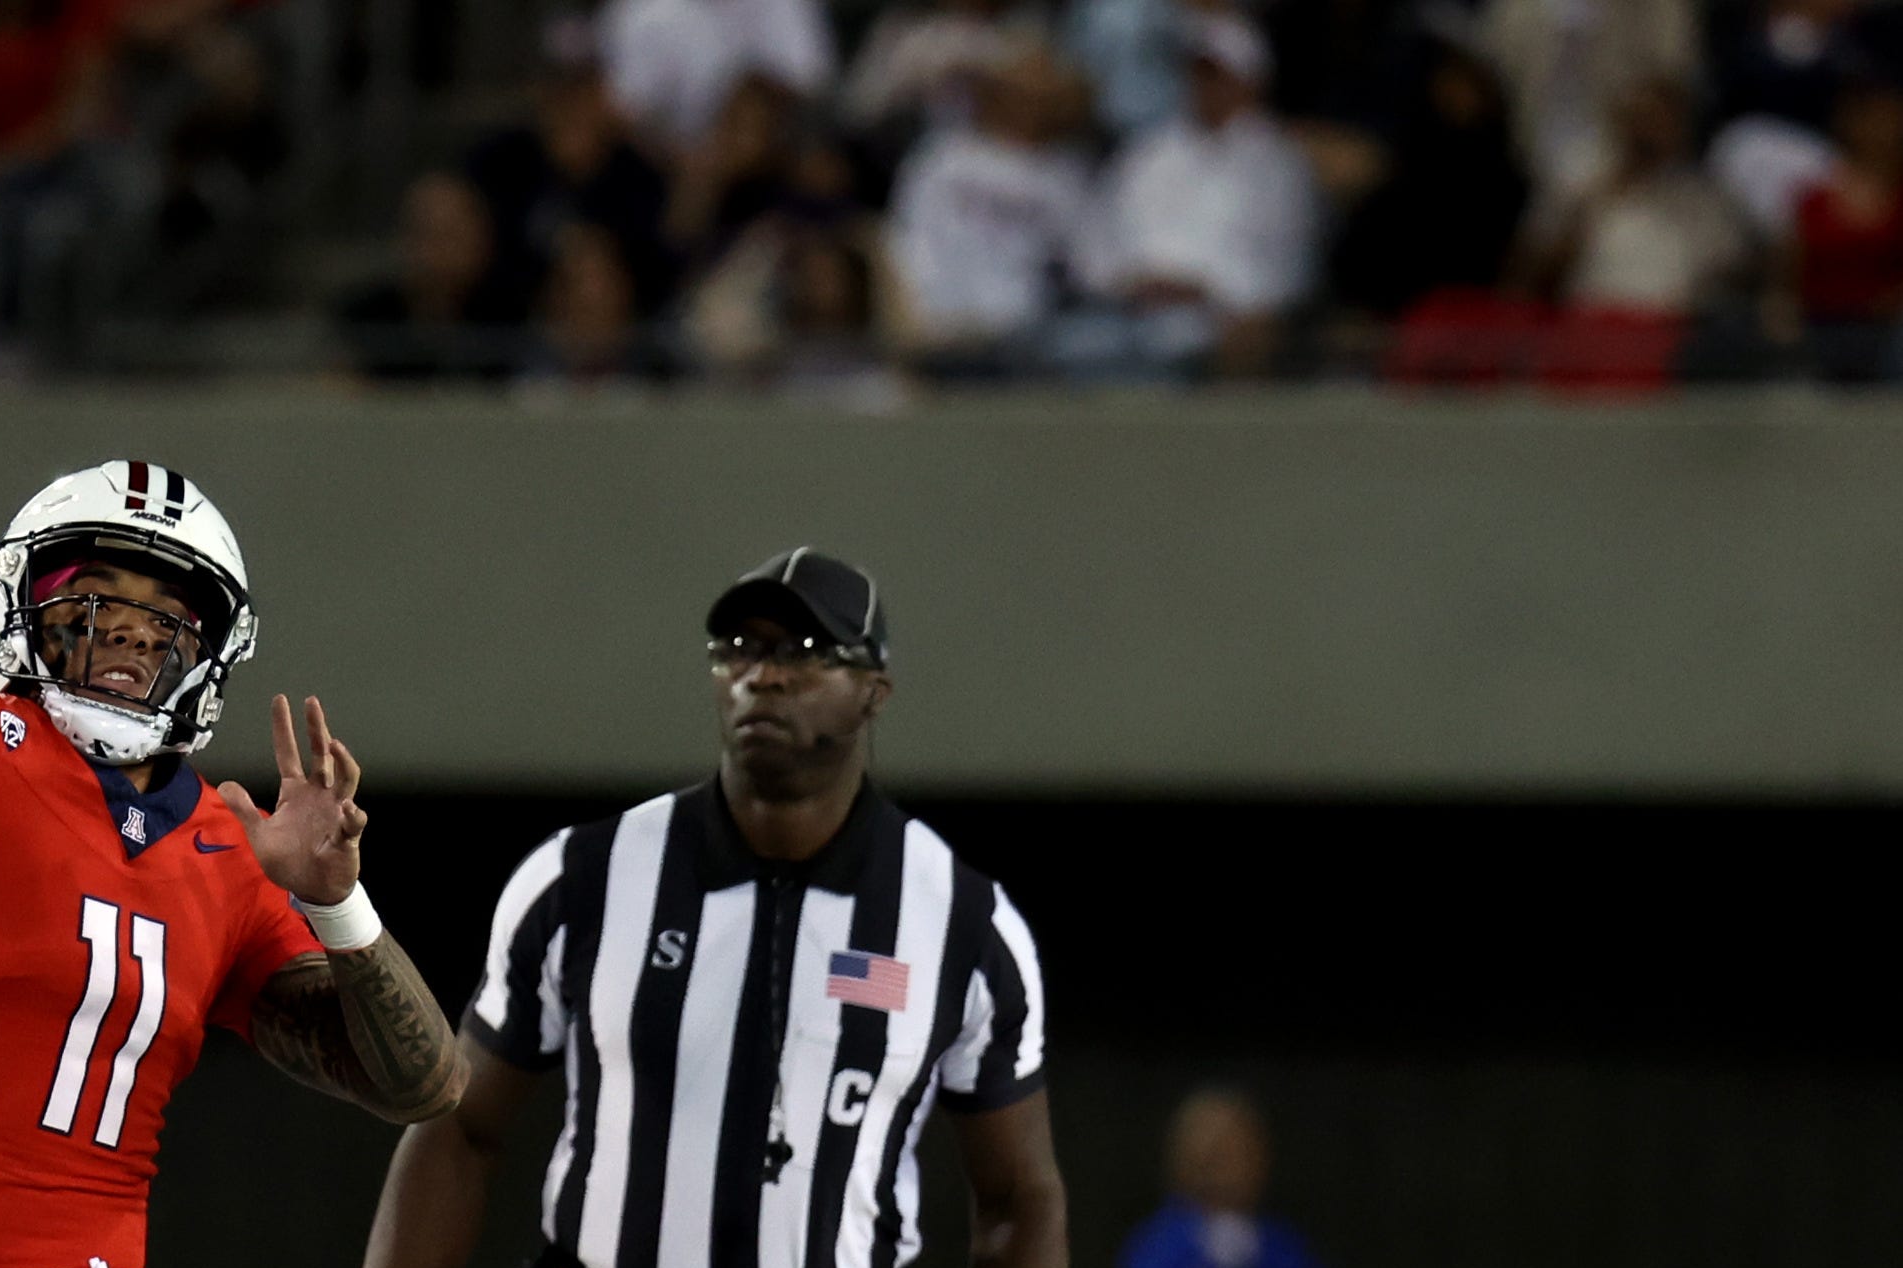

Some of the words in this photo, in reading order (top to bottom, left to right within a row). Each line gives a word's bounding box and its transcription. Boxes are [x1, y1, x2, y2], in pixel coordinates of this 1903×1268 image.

[121, 805, 146, 844] A
[651, 929, 688, 970] S
[38, 894, 167, 1150] 11
[826, 1067, 874, 1127] C
